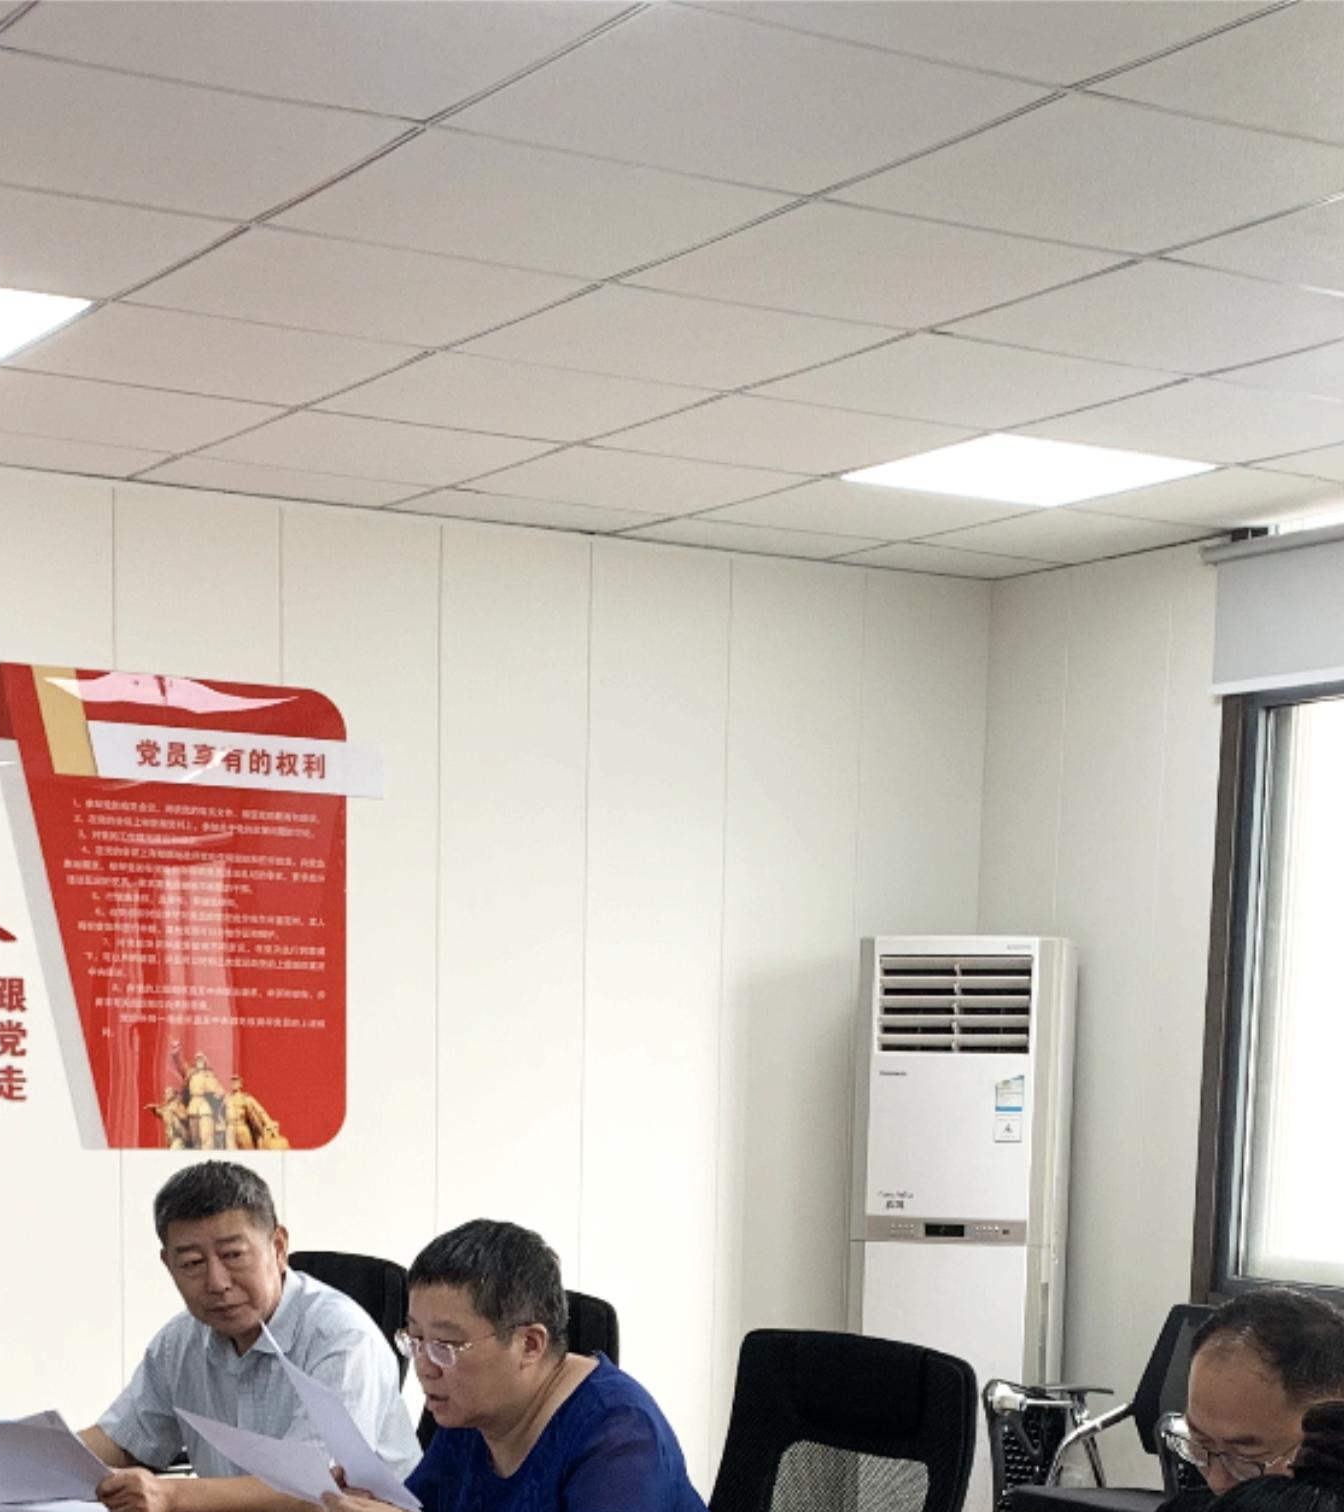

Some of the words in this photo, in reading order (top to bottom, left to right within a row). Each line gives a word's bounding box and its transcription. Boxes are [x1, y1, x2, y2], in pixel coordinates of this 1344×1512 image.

[135, 738, 327, 780] 党员享有的权利
